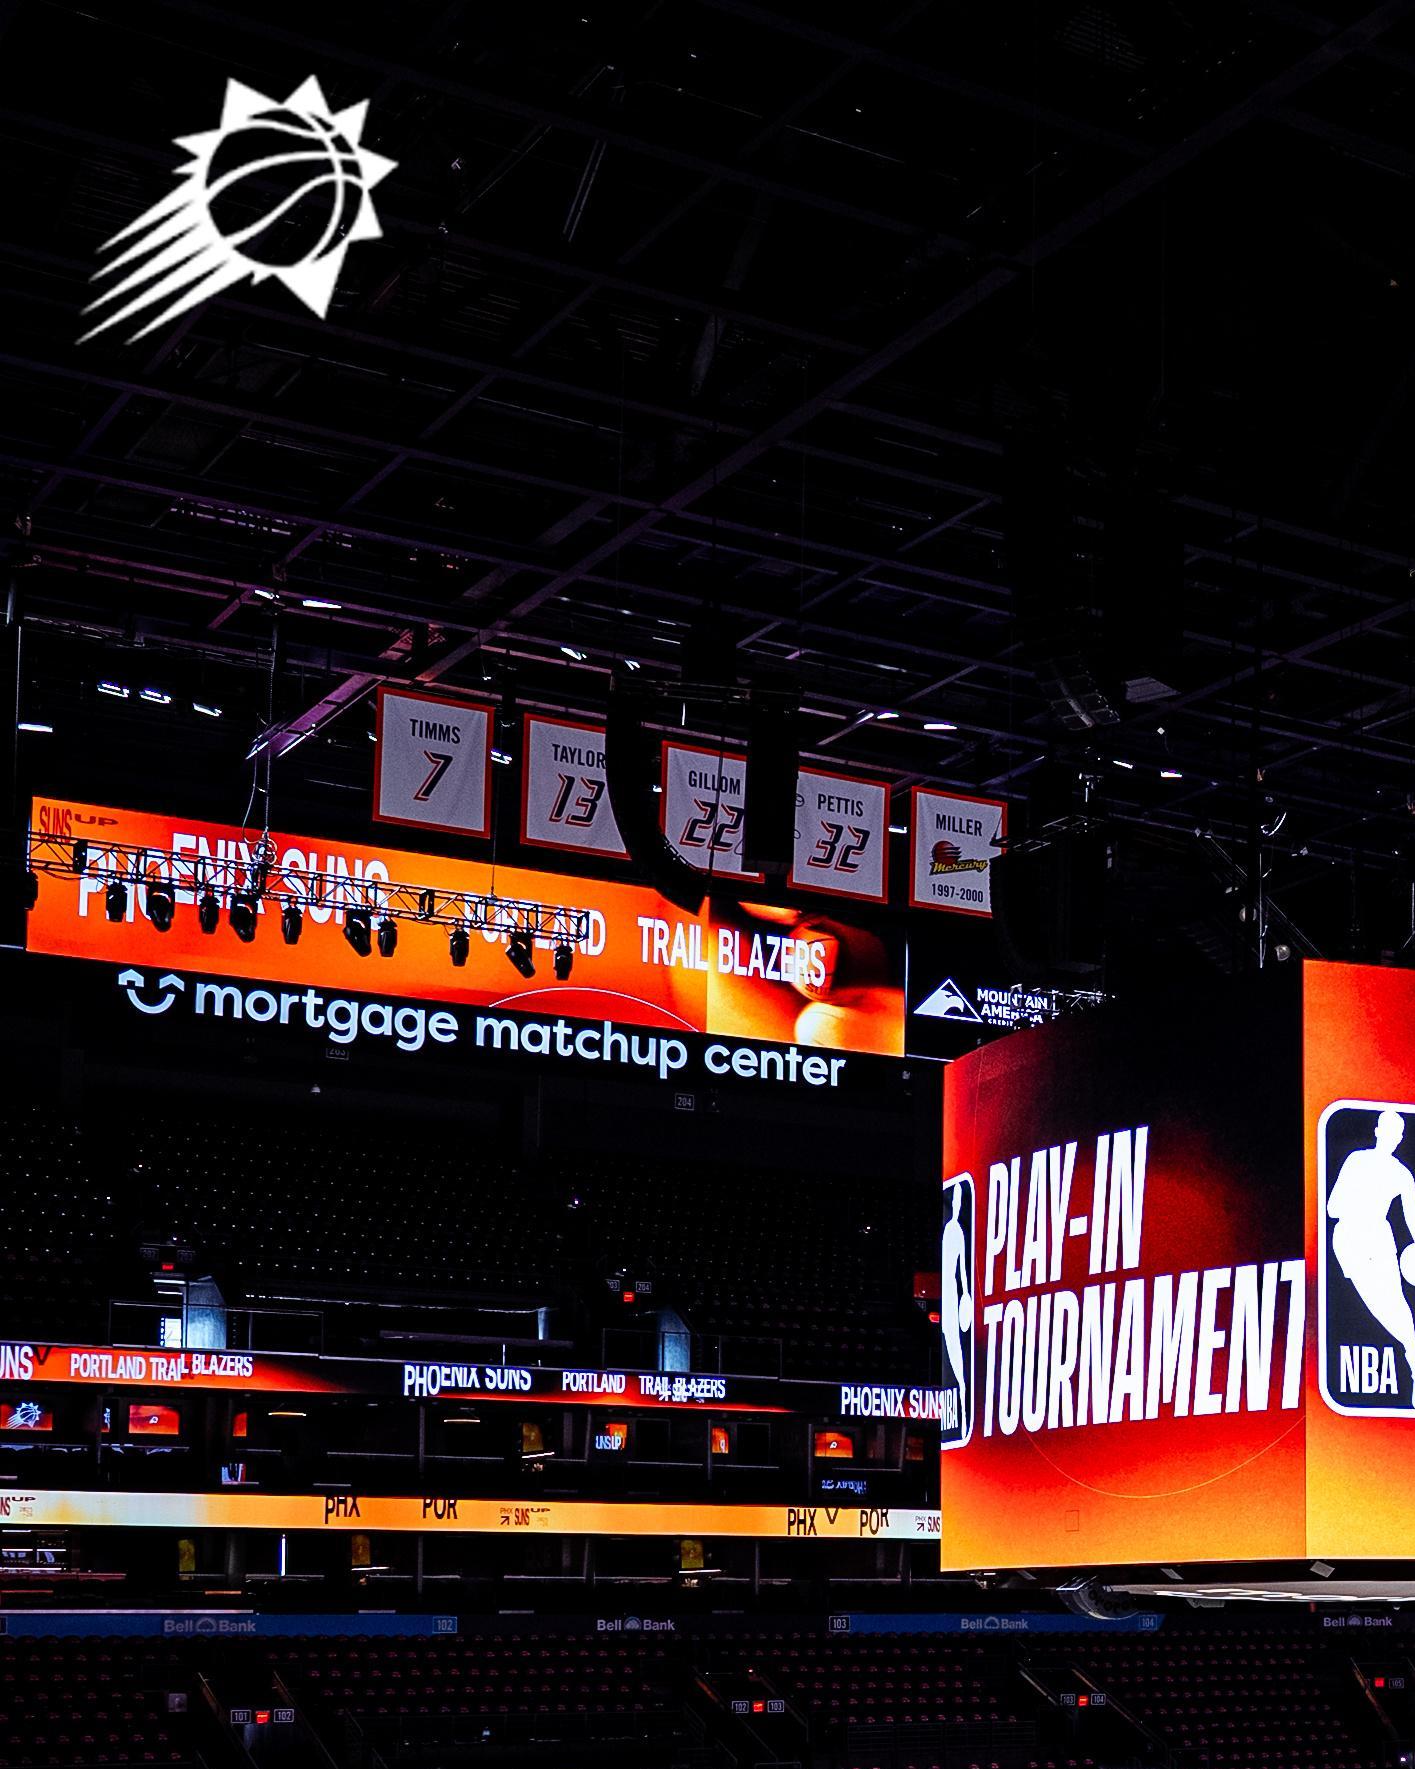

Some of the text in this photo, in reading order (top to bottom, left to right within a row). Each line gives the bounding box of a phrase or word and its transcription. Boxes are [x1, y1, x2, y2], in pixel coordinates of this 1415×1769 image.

[409, 718, 461, 745] TIMMS
[552, 743, 607, 770] TAYLOR
[413, 750, 453, 801] 7
[688, 770, 741, 796] GILLOM
[549, 773, 605, 828] 13
[817, 793, 864, 818] PETTIS
[39, 805, 119, 843] SUNS UP
[679, 798, 744, 852] 22
[935, 813, 984, 837] MILLER
[807, 821, 870, 874] 32
[930, 857, 988, 876] Mercury
[931, 883, 984, 904] 1997-2000
[637, 916, 709, 972] TRAIL
[718, 928, 826, 987] BLAZERS
[195, 980, 846, 1087] mortgage matchup center
[984, 1124, 1150, 1297] PLAY-IN
[980, 1259, 1306, 1438] TOURNAMENT
[0, 1345, 34, 1381] NS
[70, 1353, 146, 1379] PORTLAND
[150, 1353, 189, 1381] TRAIL
[192, 1353, 253, 1377] BLAZERS
[1340, 1344, 1400, 1396] NBA
[403, 1364, 480, 1397] PHOENIX
[484, 1367, 532, 1391] SUNS
[561, 1371, 626, 1393] PORTLAND
[841, 1386, 906, 1418] PHOENIX
[324, 1497, 458, 1525] PHX POR
[787, 1508, 818, 1536] PHX
[859, 1508, 890, 1537] POR
[163, 1619, 257, 1634] Bell Bank
[435, 1619, 454, 1632] 102
[597, 1619, 676, 1632] Bell Bank
[832, 1618, 847, 1630] 103
[960, 1617, 1029, 1630] Bell Bank
[1323, 1615, 1393, 1628] Bell Bank
[234, 1712, 249, 1722] 101
[277, 1711, 291, 1721] 102
[735, 1702, 747, 1711] 102
[770, 1701, 782, 1711] 103
